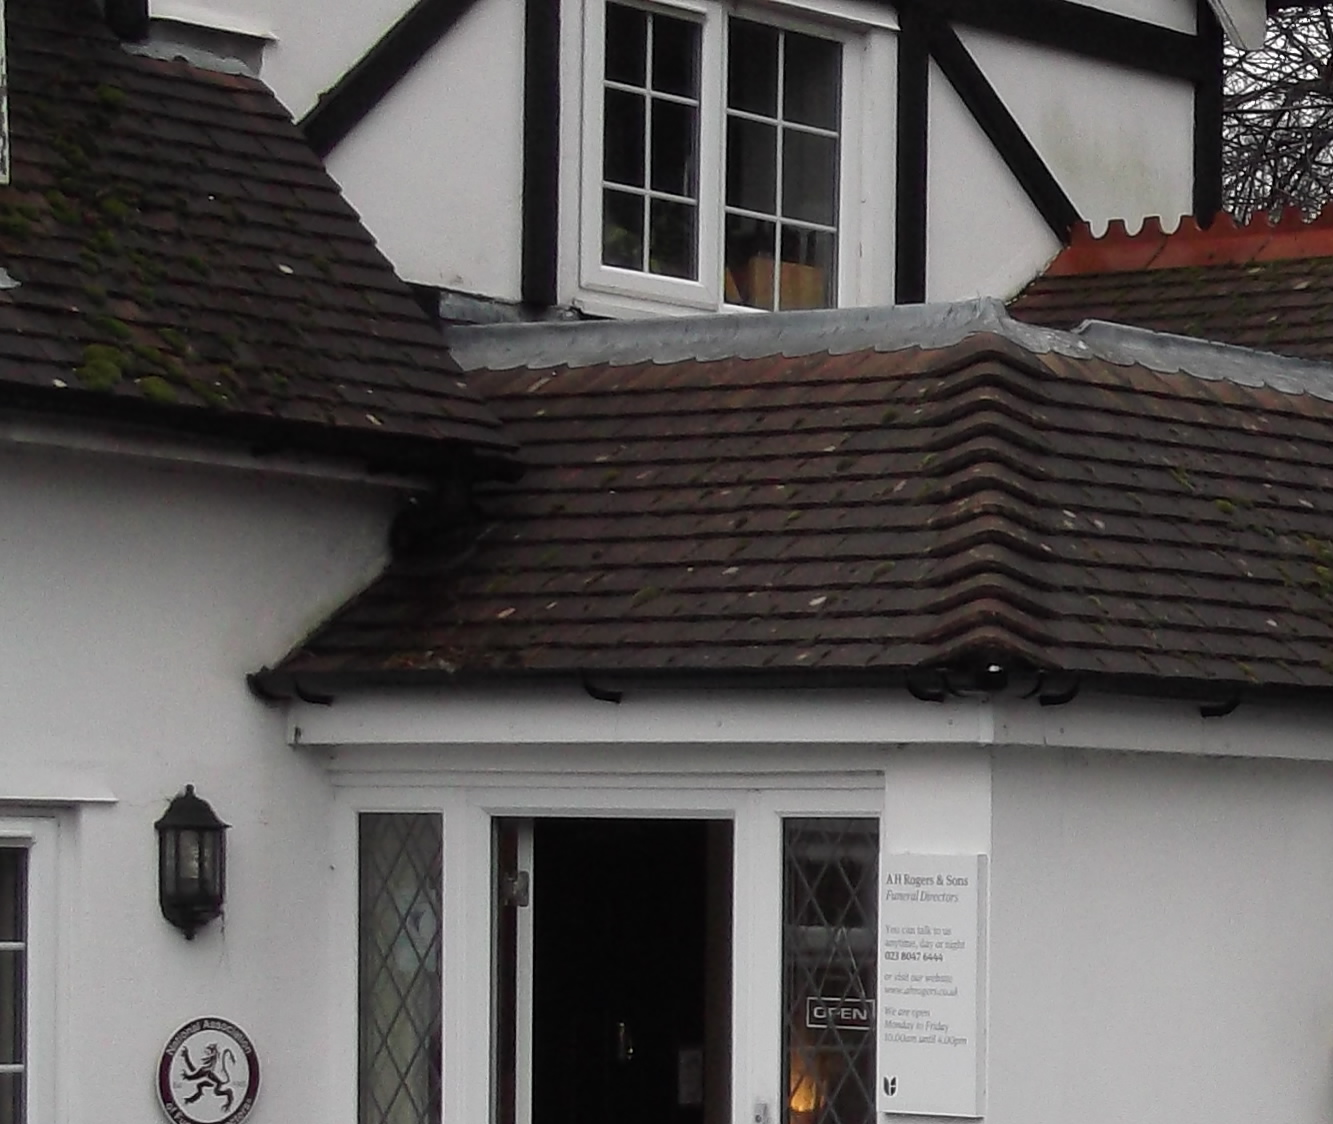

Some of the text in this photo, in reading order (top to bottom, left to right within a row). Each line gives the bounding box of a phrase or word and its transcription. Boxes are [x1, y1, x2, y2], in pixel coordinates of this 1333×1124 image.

[903, 873, 934, 887] Rogers
[936, 874, 943, 886] &
[946, 874, 969, 886] Sons
[885, 889, 959, 902] Funeral Directors
[885, 925, 952, 936] You can talk to us
[935, 941, 943, 949] or
[884, 951, 943, 962] 023 8047 6444
[813, 1006, 868, 1020] OPEN
[925, 1020, 949, 1034] Friday
[165, 1021, 202, 1056] National
